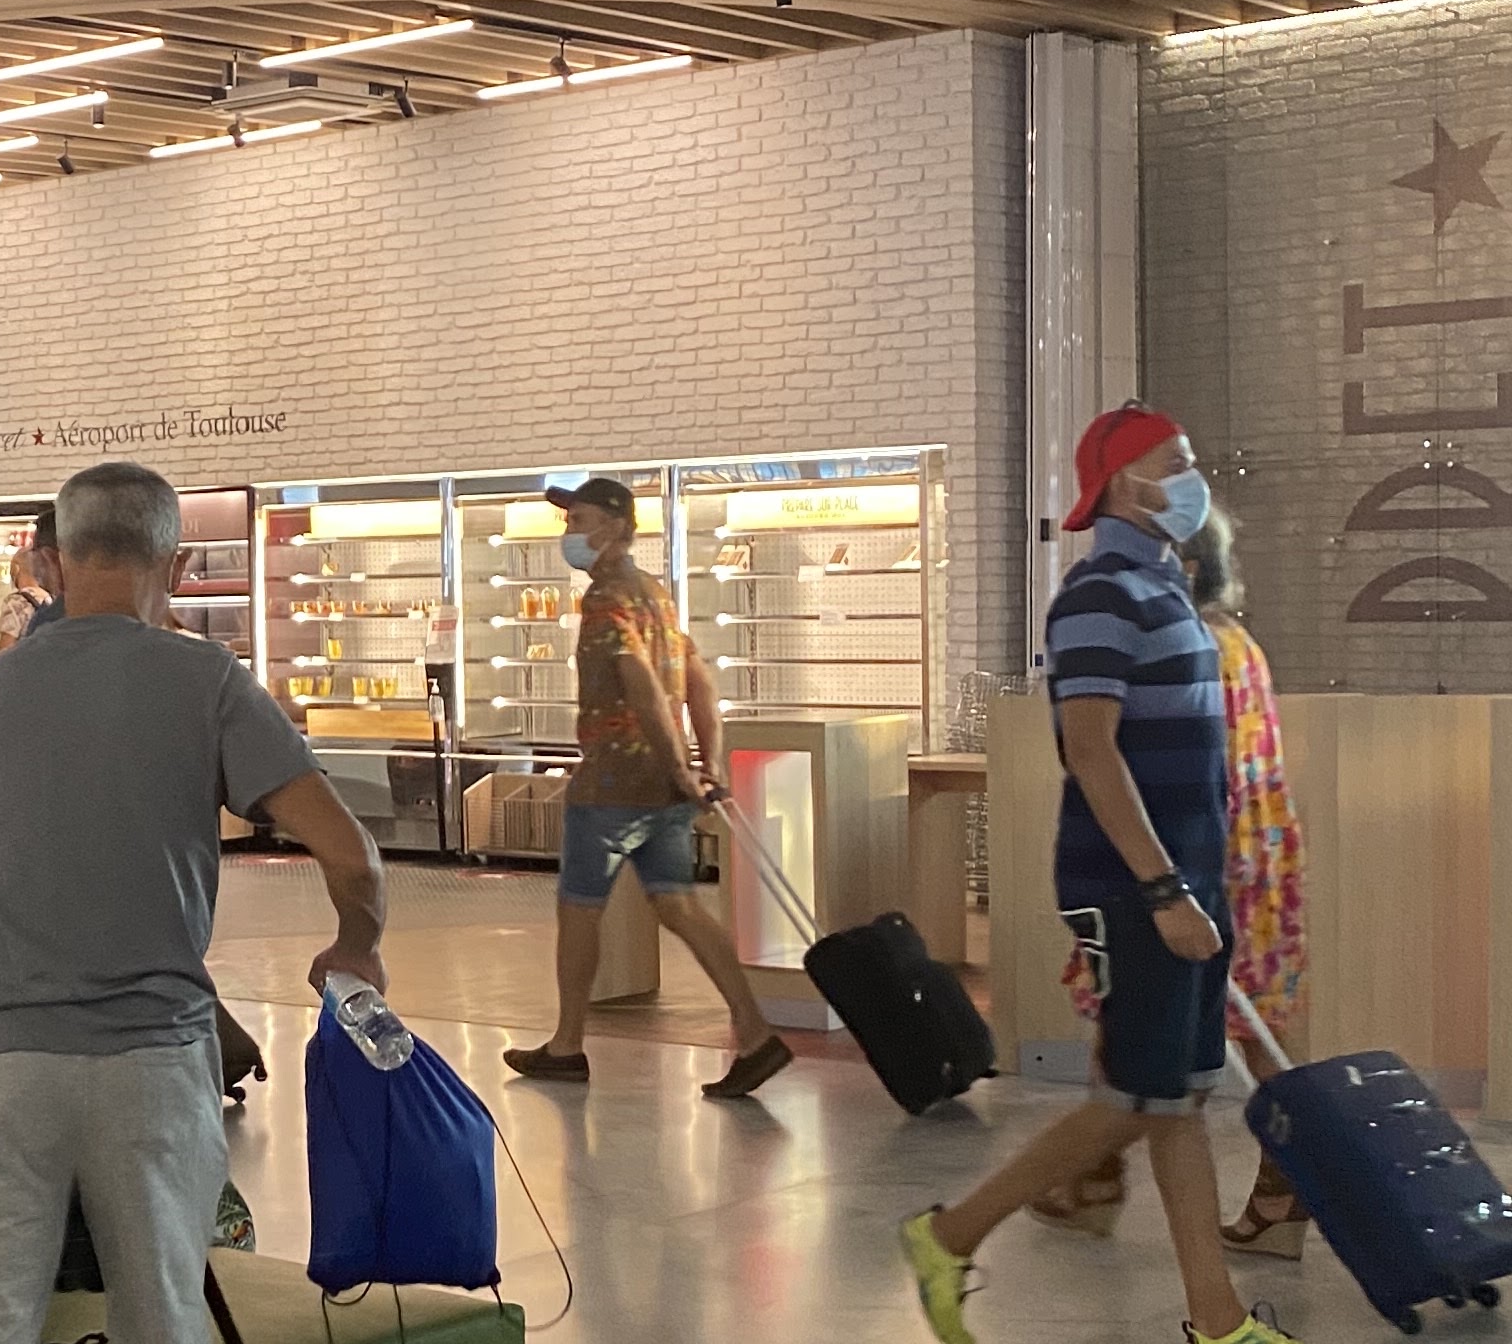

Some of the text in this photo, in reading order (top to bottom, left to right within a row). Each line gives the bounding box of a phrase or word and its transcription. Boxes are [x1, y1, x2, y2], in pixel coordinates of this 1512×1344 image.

[53, 420, 145, 453] Aéroport
[154, 412, 178, 440] de
[184, 407, 287, 438] Toulouse
